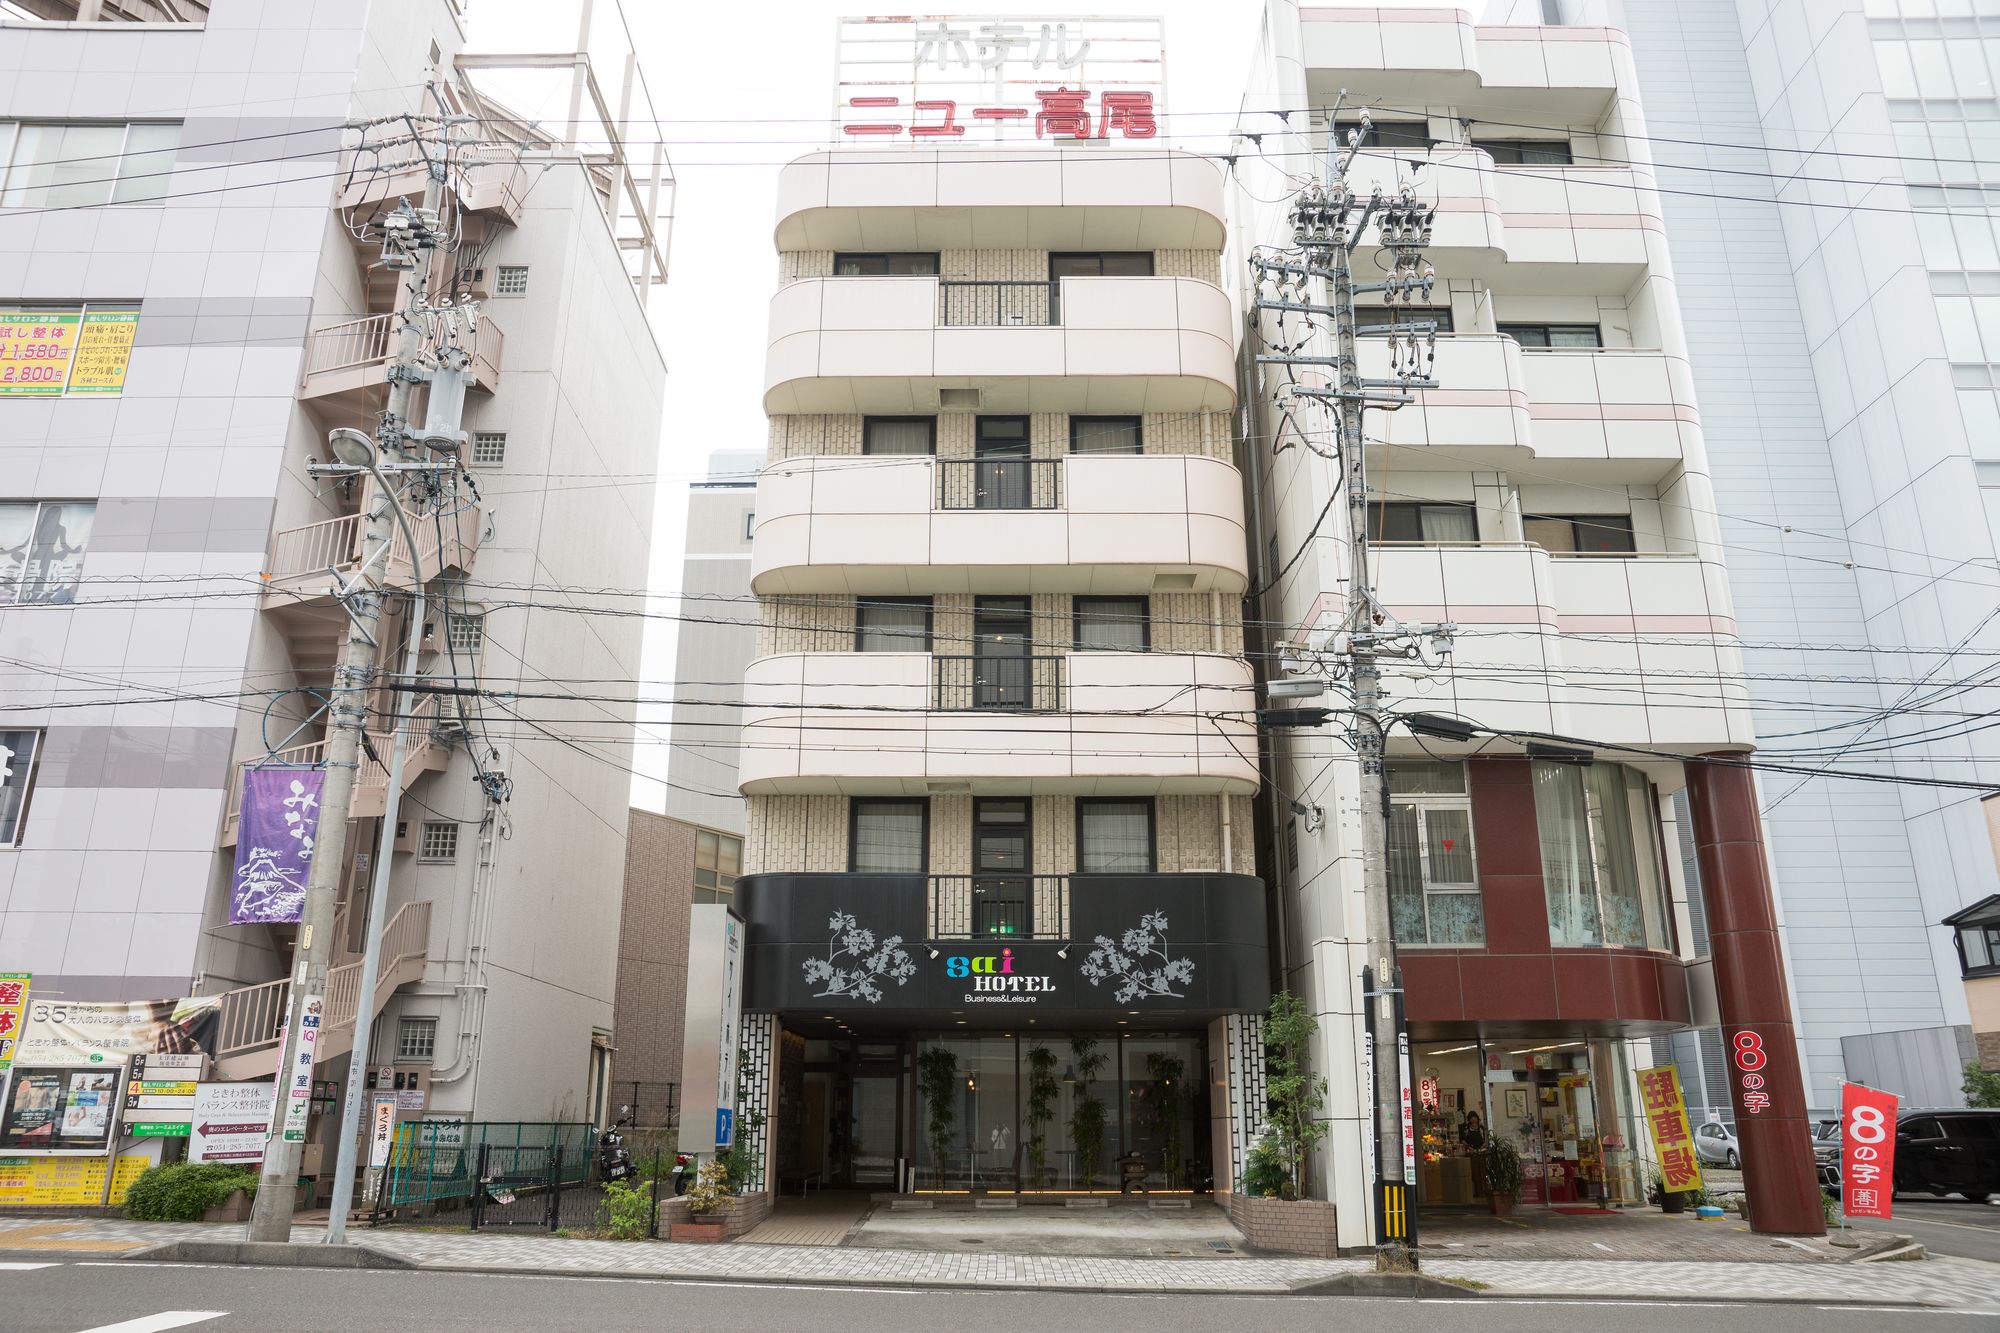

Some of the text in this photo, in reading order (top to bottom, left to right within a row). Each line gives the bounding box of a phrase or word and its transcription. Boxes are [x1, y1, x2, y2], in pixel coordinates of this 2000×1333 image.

[914, 22, 1090, 70] ホテル
[843, 87, 1157, 139] ニュー高尾
[974, 976, 1056, 992] HOTEL
[964, 994, 1037, 1003] Business&Leisure
[1733, 1030, 1770, 1114] 8の字
[130, 1083, 139, 1094] 4
[211, 1087, 261, 1098] ときわ整体
[200, 1100, 271, 1111] バランス整骨院
[377, 1107, 388, 1141] まぐろ丼
[1849, 1105, 1886, 1184] 8の字
